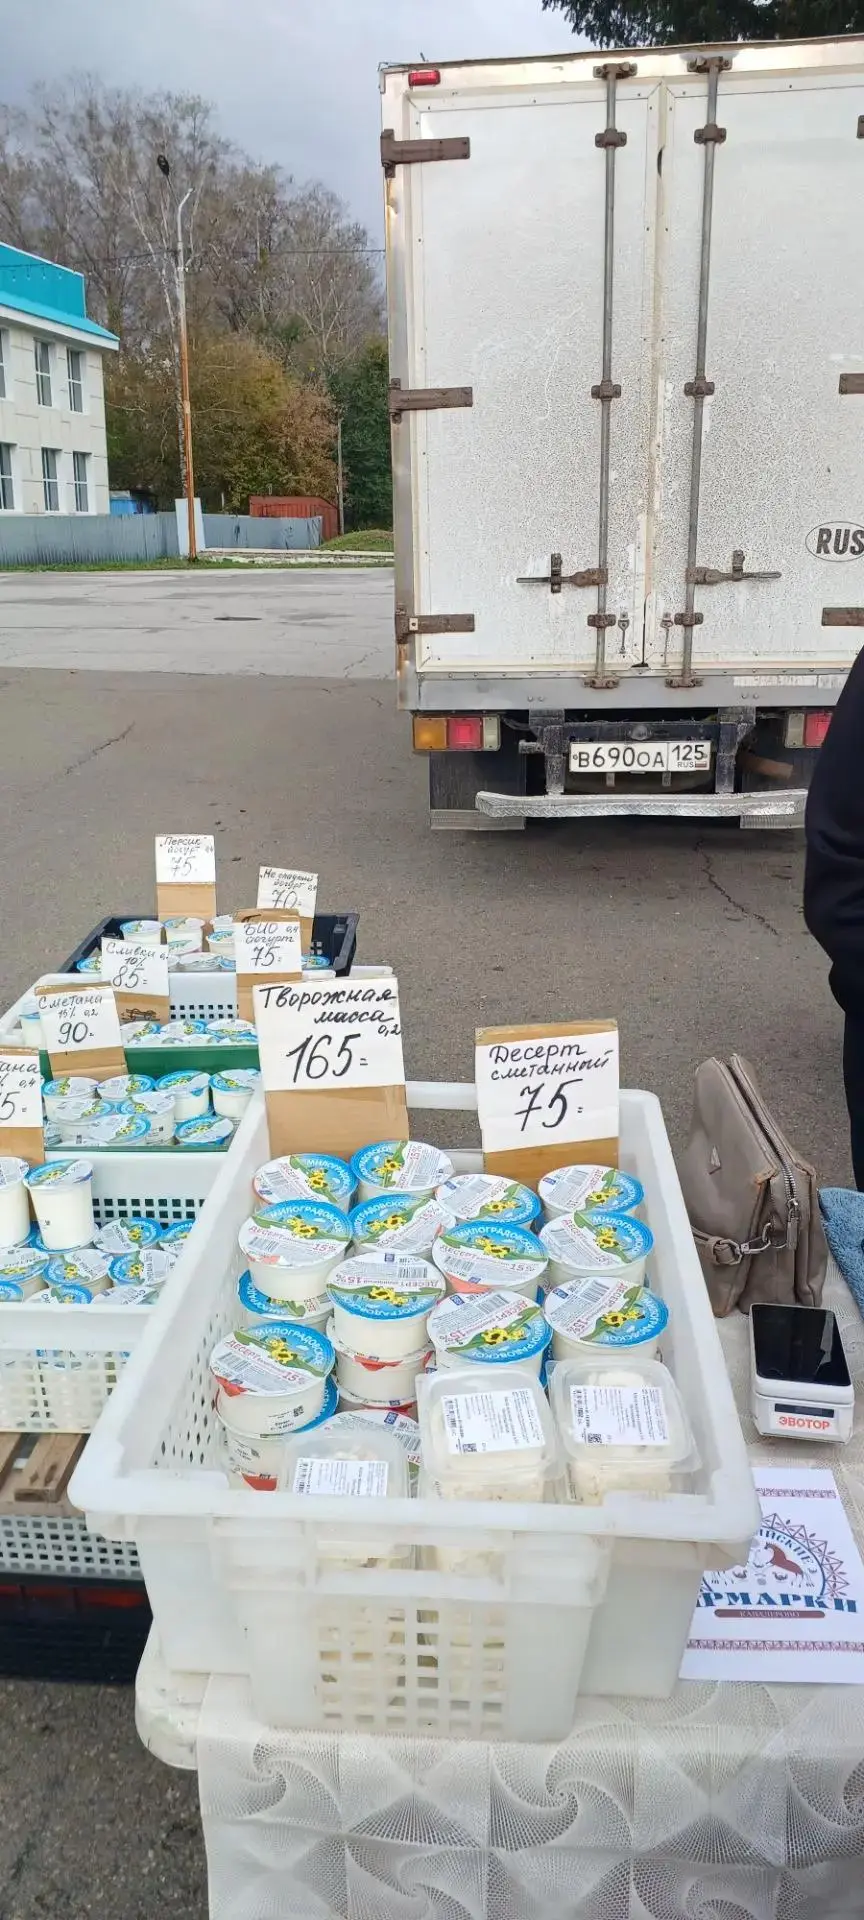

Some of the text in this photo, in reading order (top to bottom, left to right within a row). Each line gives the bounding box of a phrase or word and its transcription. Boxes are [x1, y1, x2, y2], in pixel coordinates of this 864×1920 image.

[815, 527, 864, 556] RUS
[671, 744, 704, 760] 125
[124, 956, 147, 968] 10%
[38, 994, 103, 1011] Сметана
[259, 985, 398, 1011] Творожная
[57, 1006, 99, 1019] 15% 0,2
[313, 1007, 395, 1026] масса
[377, 1023, 402, 1037] 0,2
[489, 1043, 585, 1068] Десерт
[0, 1062, 40, 1074] ана
[490, 1049, 613, 1081] сметанный
[0, 1090, 27, 1121] 5=
[778, 1414, 831, 1431] ЭВОТОР
